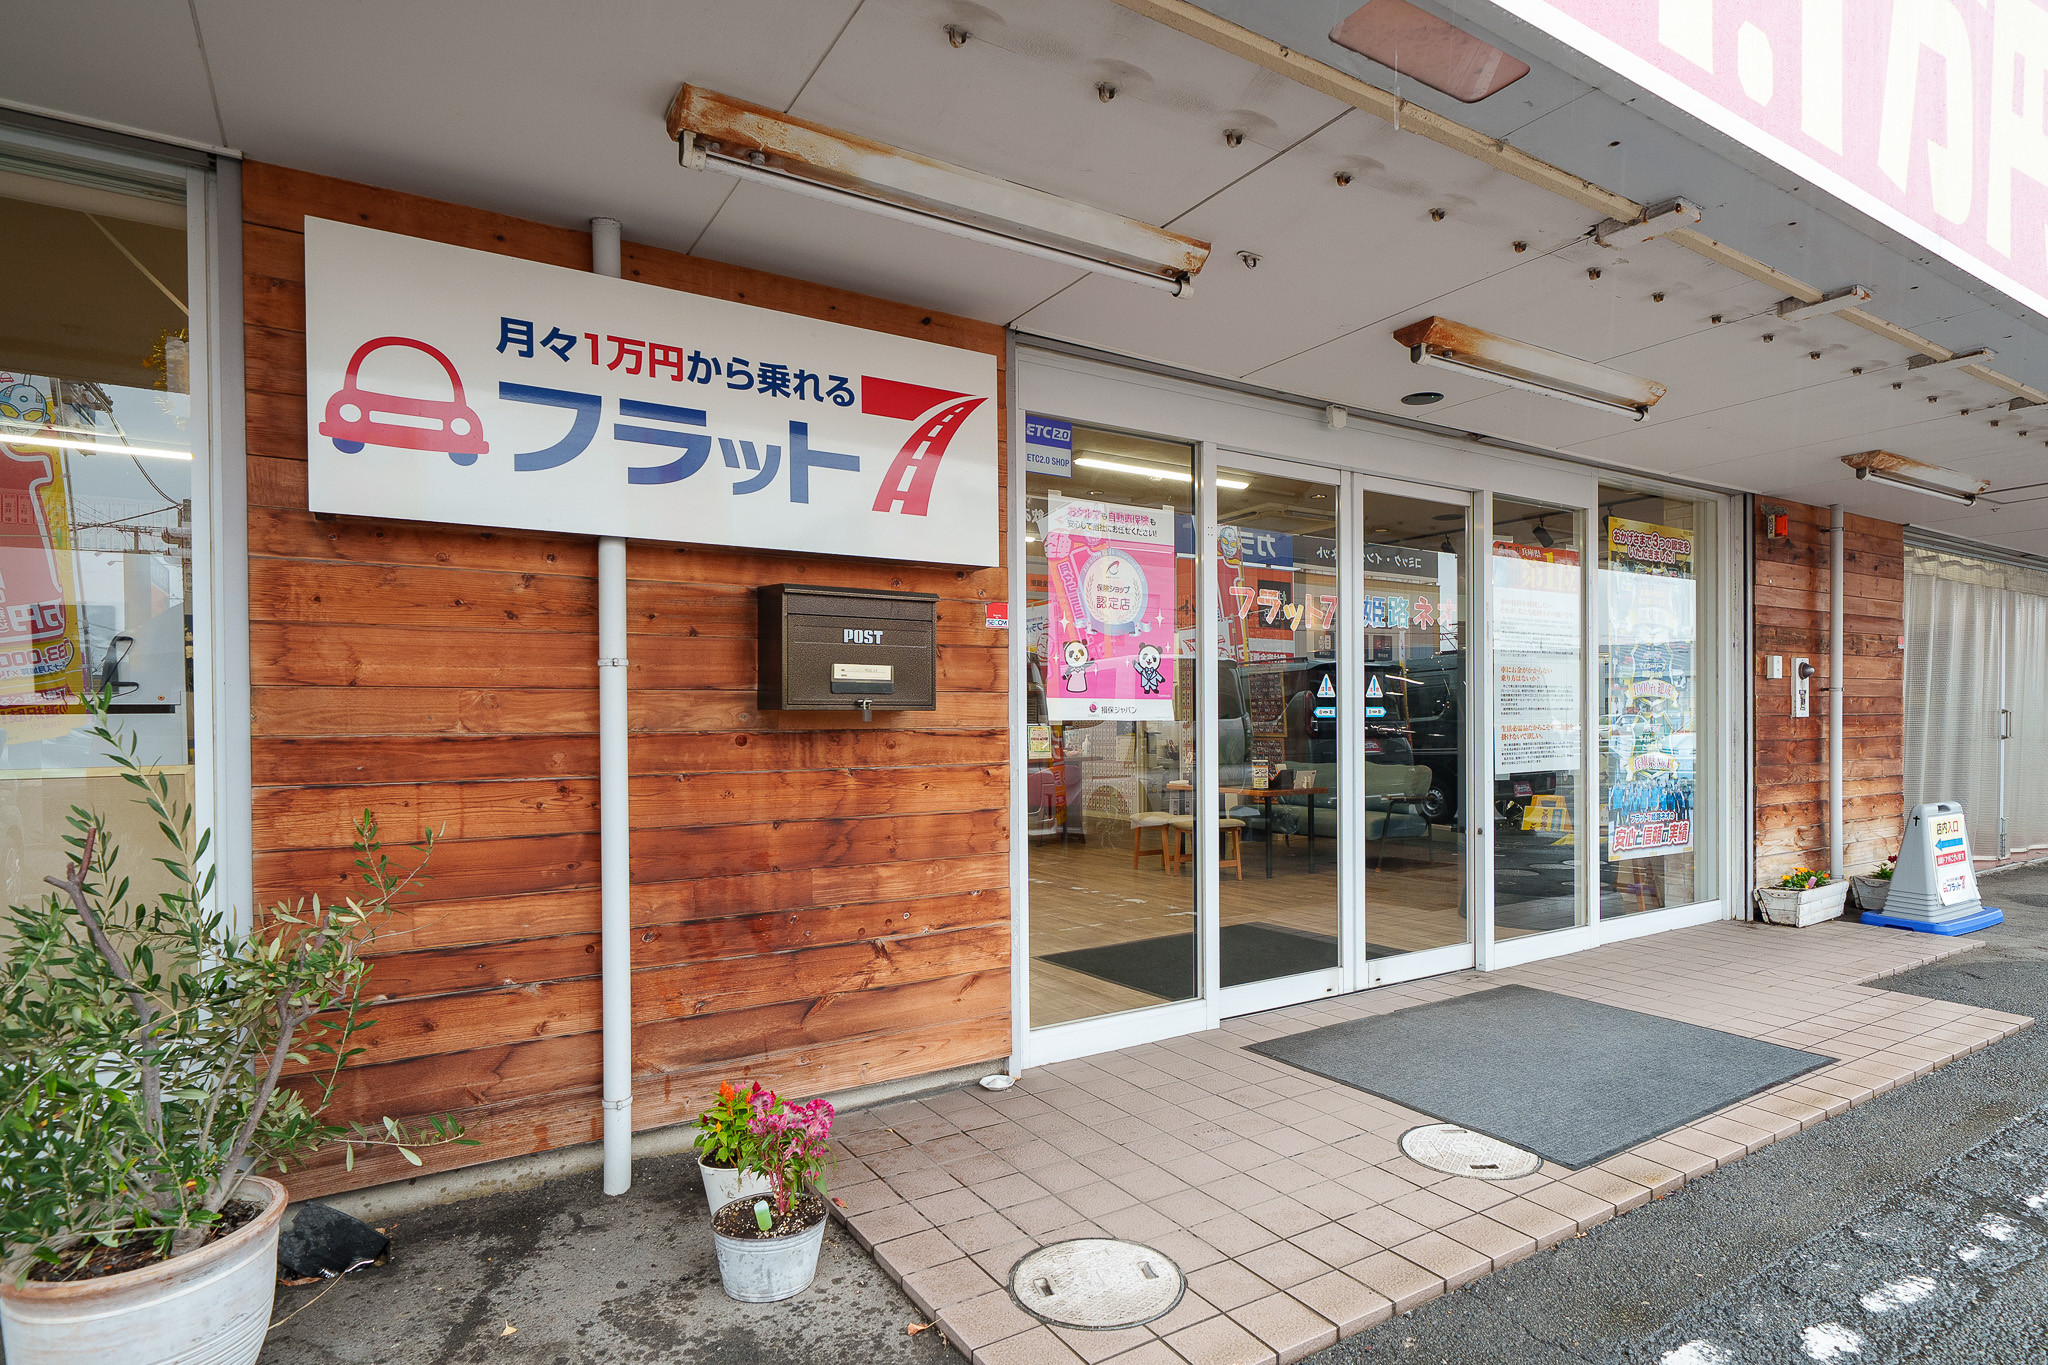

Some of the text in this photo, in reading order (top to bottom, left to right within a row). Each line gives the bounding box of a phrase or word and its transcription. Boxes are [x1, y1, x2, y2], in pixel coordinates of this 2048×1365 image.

[496, 316, 855, 406] 月々1万円から乗れる
[1026, 453, 1070, 467] ETC2.0 SHOP
[1612, 529, 1691, 554] おかげさまで3つの認定を
[1628, 545, 1676, 563] いただきました!
[1096, 583, 1131, 594] 保険ショップ
[1096, 595, 1131, 611] 認定店
[987, 619, 1008, 627] SECOM
[843, 628, 884, 645] POST
[1101, 706, 1138, 715] 損保ジャパン
[1615, 823, 1689, 848] 安心と信頼の実績
[1936, 820, 1959, 835] 店内入口
